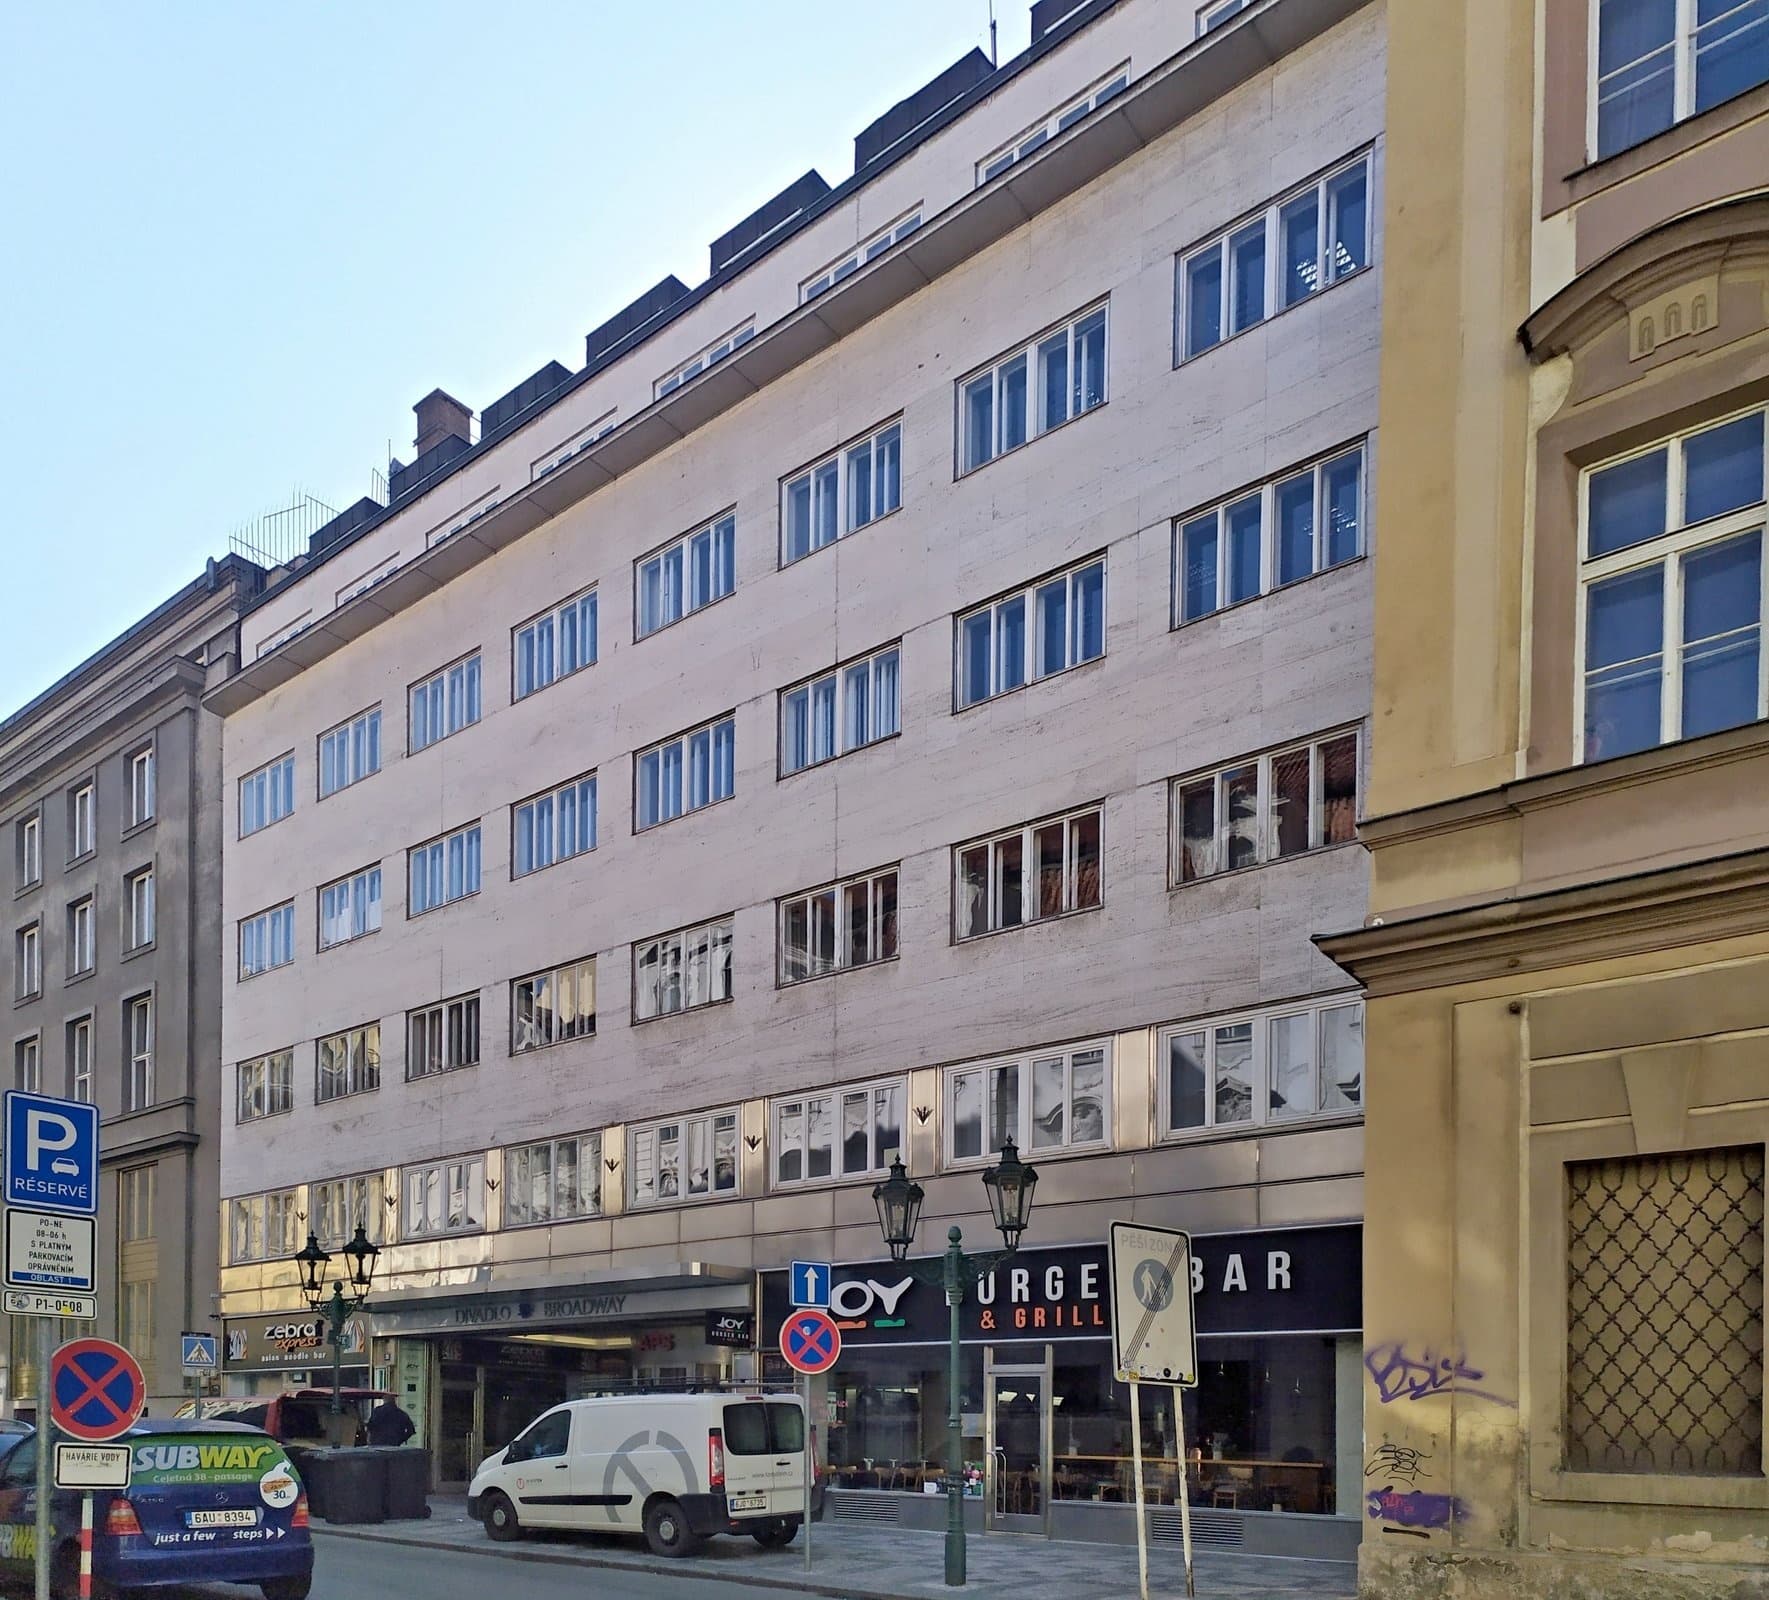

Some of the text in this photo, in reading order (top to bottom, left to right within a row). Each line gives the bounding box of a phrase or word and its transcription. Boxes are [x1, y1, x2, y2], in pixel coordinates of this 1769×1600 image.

[26, 1108, 78, 1172] P
[14, 1176, 88, 1199] RÉSERVÉ
[39, 1218, 64, 1229] PO-NE
[36, 1229, 59, 1239] 08-06
[30, 1240, 72, 1251] S PLATNÝM
[1149, 1236, 1177, 1255] ZÓN
[28, 1251, 74, 1263] PARKOVACÍM
[30, 1273, 65, 1284] OBLAST
[830, 1249, 1293, 1317] OY URGE BAR
[35, 1298, 83, 1313] P1-0508
[455, 1295, 627, 1324] DIVADLO BROADWAY
[715, 1316, 745, 1330] JOY
[980, 1304, 1104, 1329] & GRILL
[263, 1323, 316, 1340] zebra
[274, 1337, 319, 1353] express
[284, 1352, 309, 1361] noodle
[313, 1351, 327, 1360] bar
[100, 1452, 120, 1463] VODY
[131, 1445, 273, 1473] SUBWAY
[194, 1472, 207, 1482] 38
[214, 1473, 253, 1483] passage
[273, 1490, 286, 1500] 30
[194, 1511, 251, 1524] 6AU 8394
[154, 1529, 263, 1546] just a few steps
